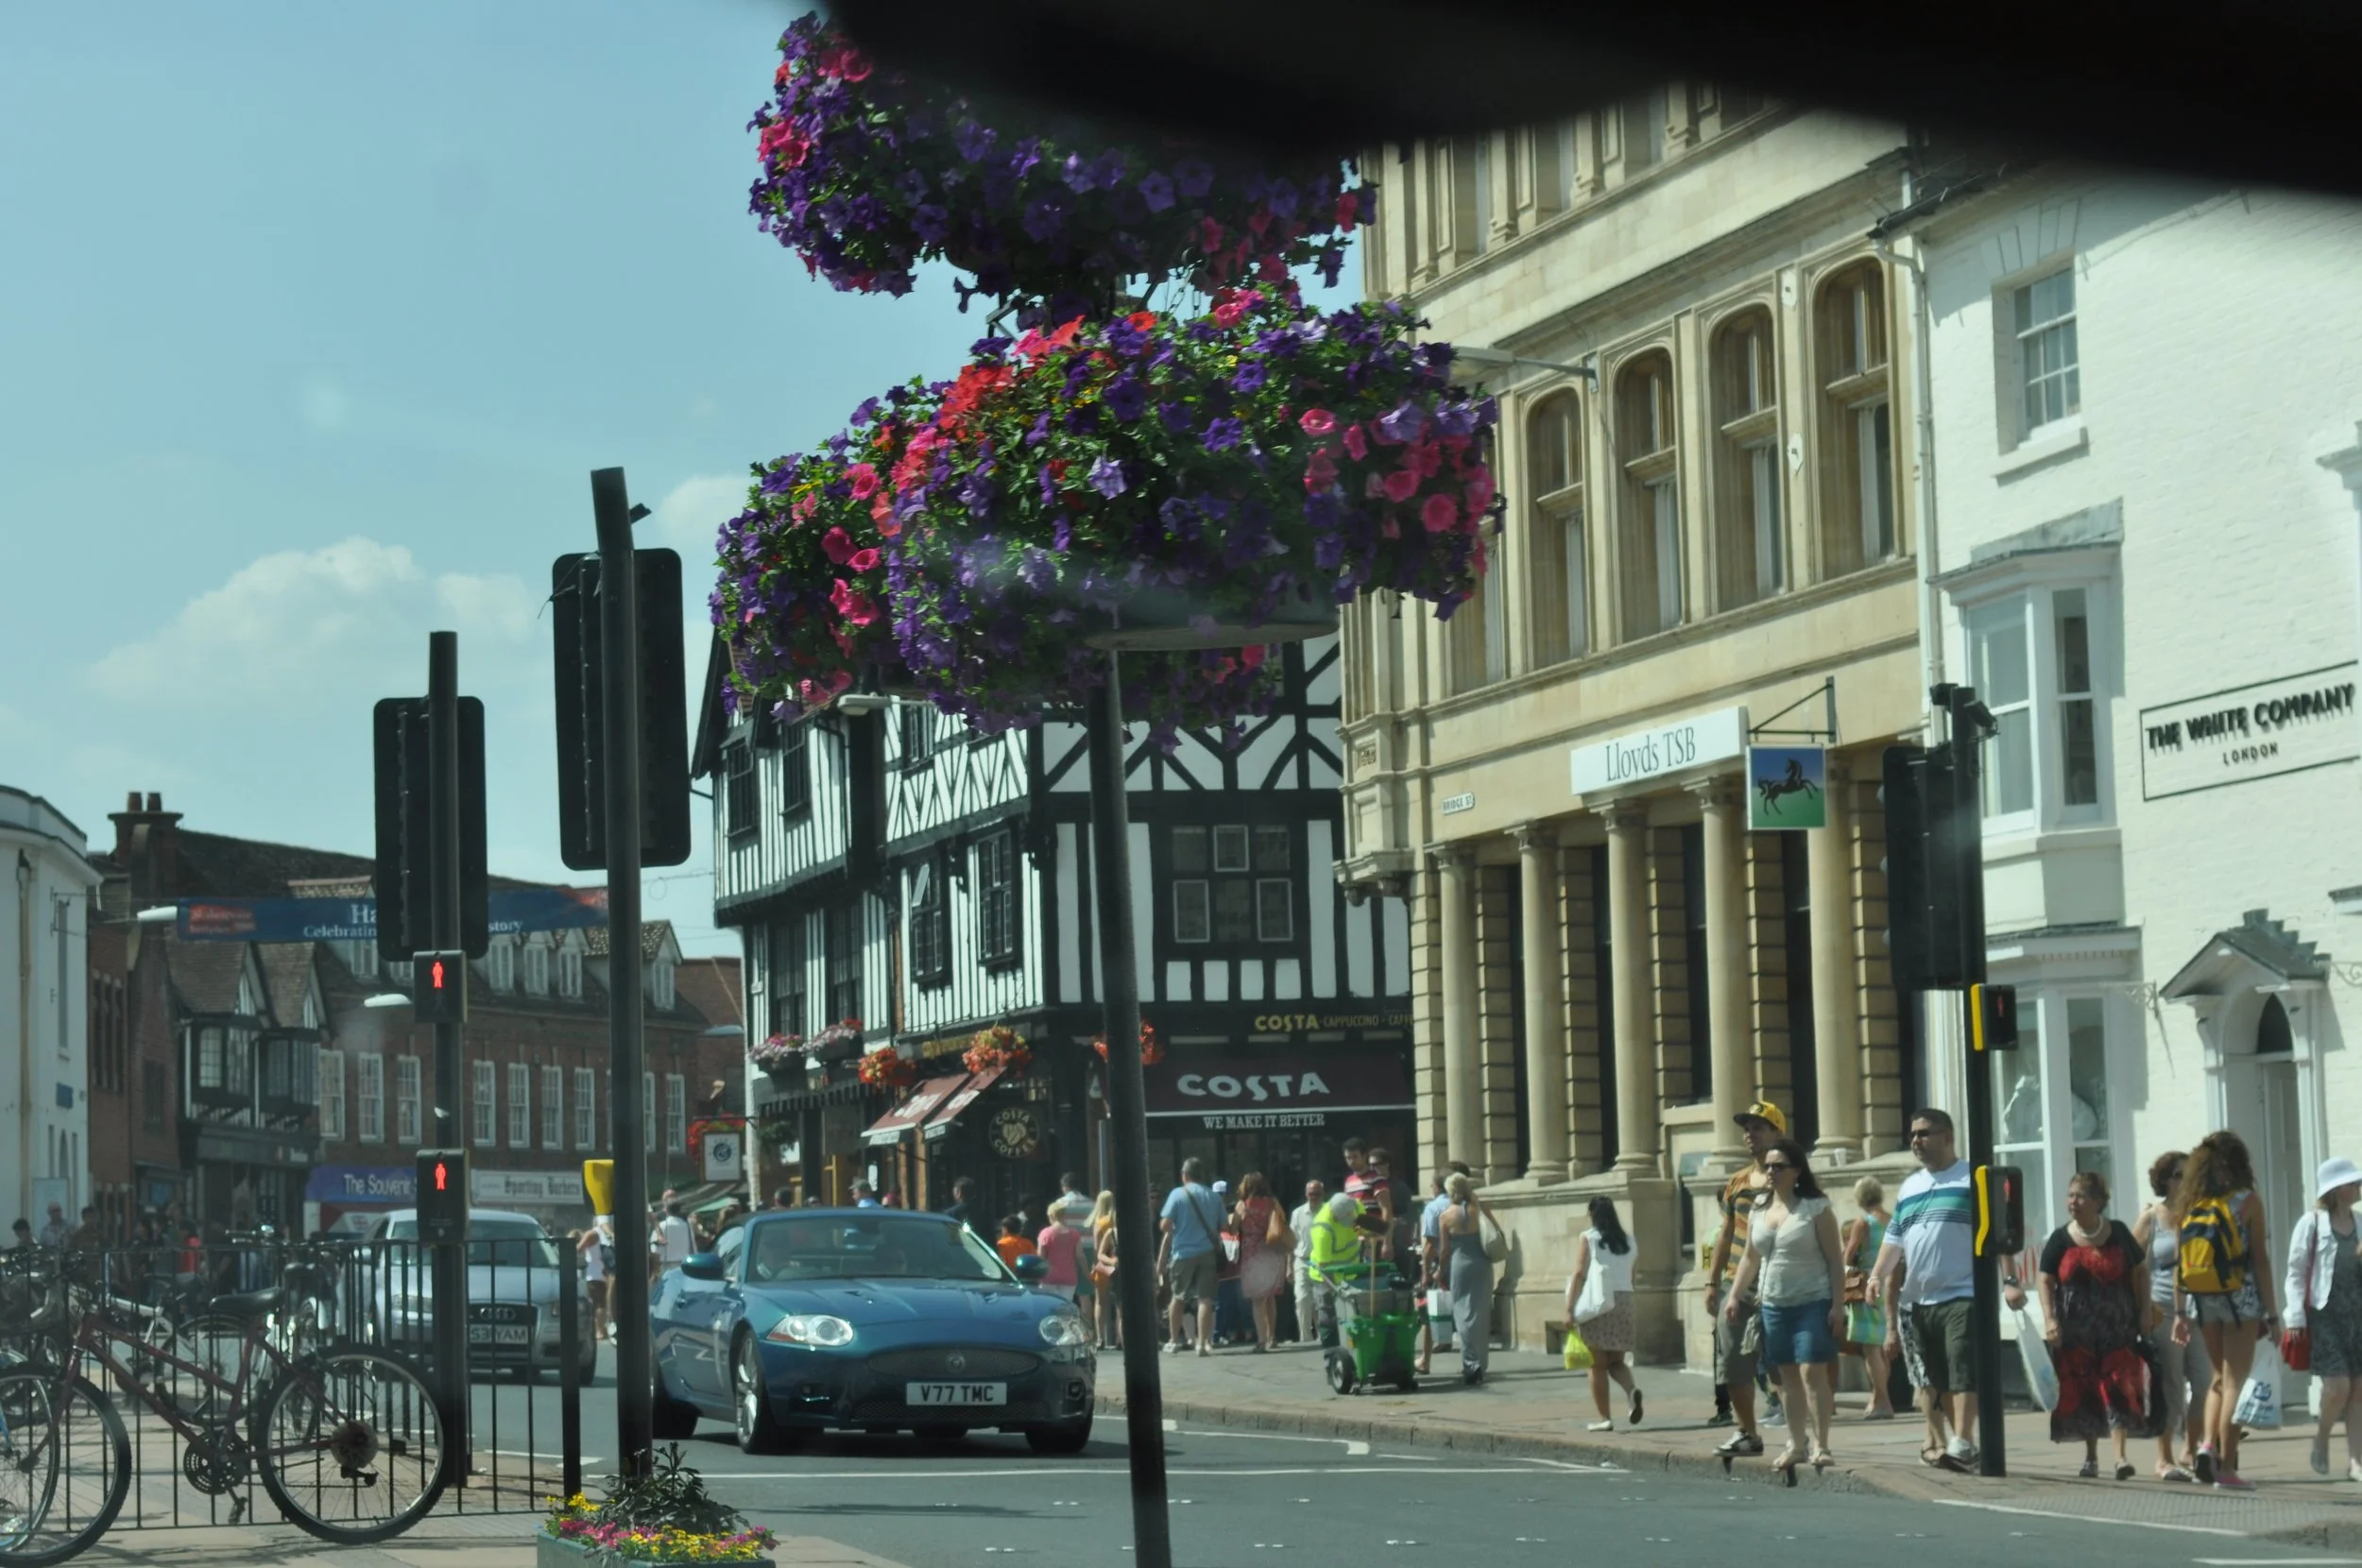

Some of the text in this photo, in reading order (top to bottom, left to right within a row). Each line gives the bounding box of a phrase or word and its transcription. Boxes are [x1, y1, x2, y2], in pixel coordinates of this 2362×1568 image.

[2146, 683, 2355, 750] THE WHITE COMPANY
[1606, 726, 1696, 782] Lloyds TSB
[2223, 742, 2279, 766] LONDON
[1443, 797, 1463, 810] BRIDGE
[302, 920, 523, 938] Celebratin story
[1254, 1014, 1320, 1032] COSTA
[1324, 1014, 1379, 1028] CAPPUCCINO
[1177, 1072, 1330, 1101] COSTA
[996, 1109, 1031, 1125] COSTA
[1203, 1114, 1325, 1130] WE MAKE IT BETTER
[994, 1136, 1036, 1156] COFFEE
[343, 1173, 365, 1195] The
[920, 1385, 995, 1402] V77 TMC
